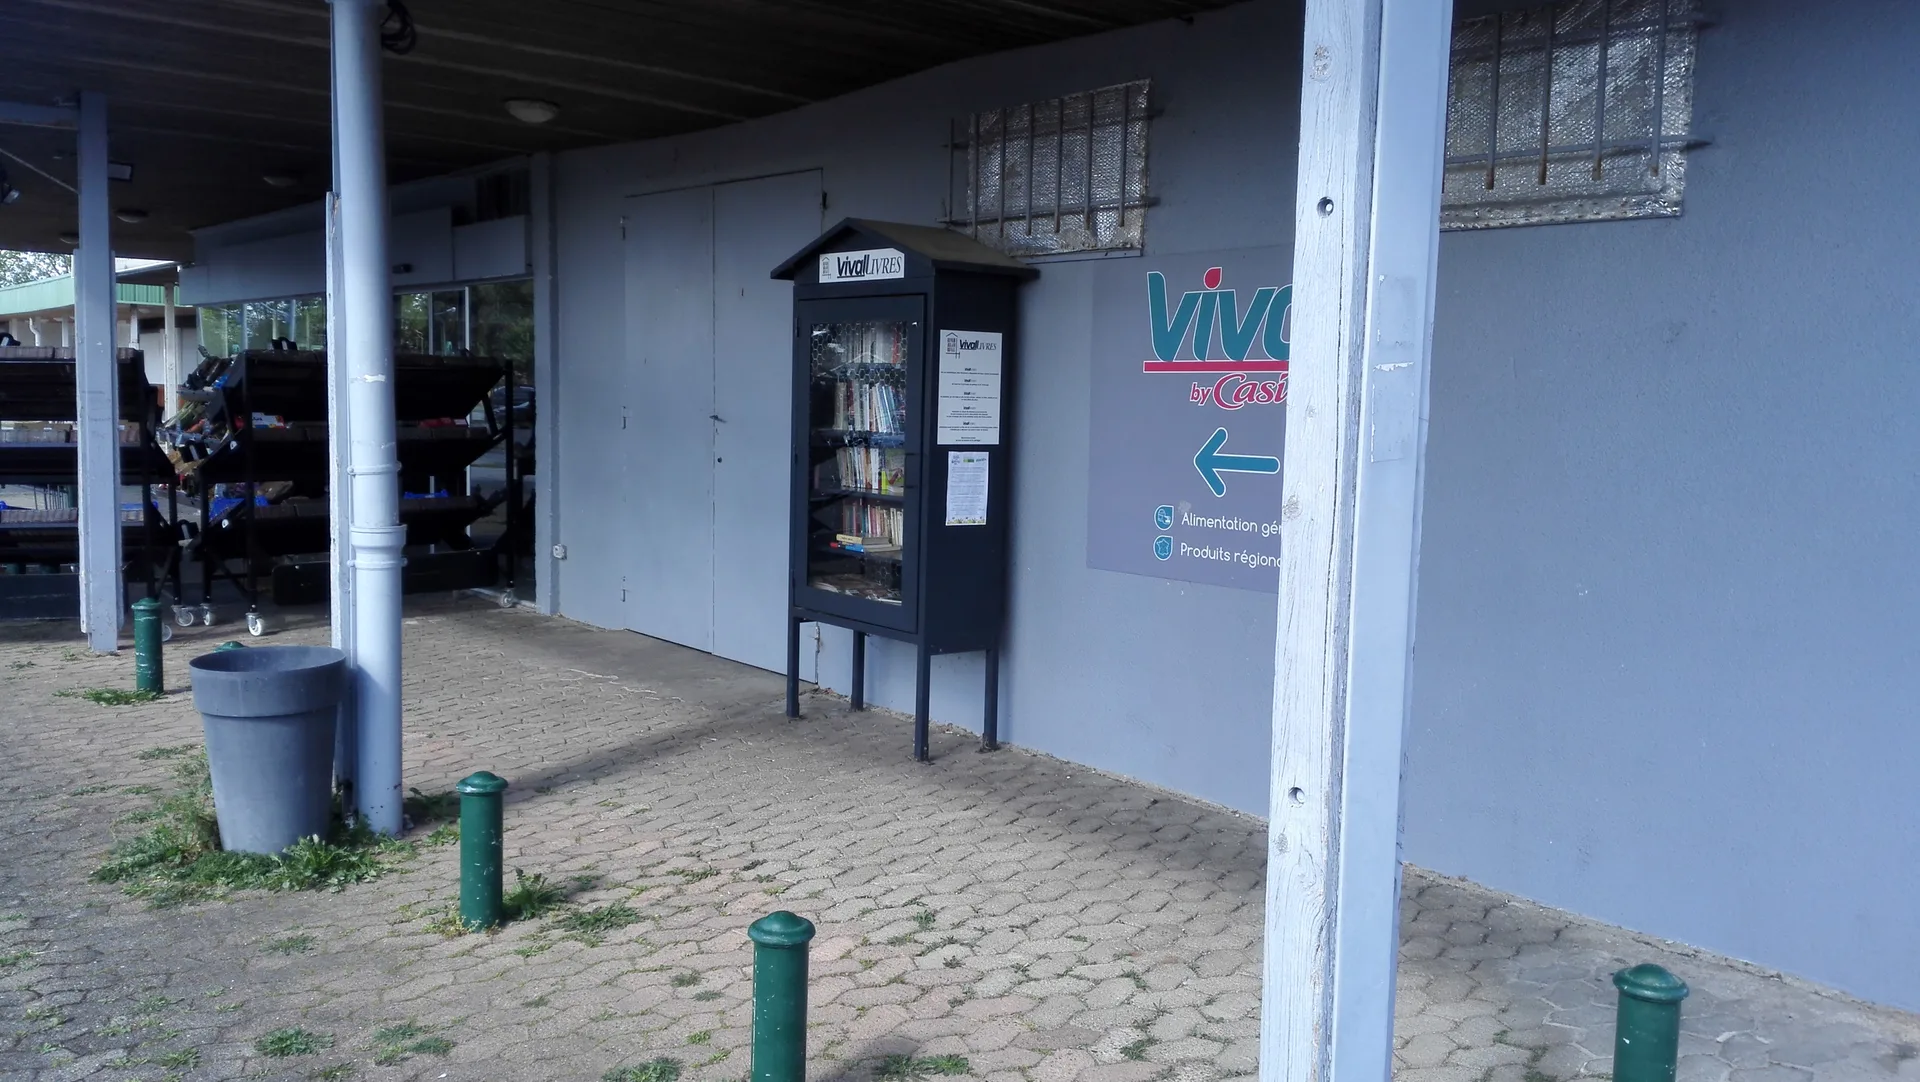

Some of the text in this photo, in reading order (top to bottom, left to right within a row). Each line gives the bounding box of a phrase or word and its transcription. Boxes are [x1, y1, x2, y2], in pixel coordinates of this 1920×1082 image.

[1190, 382, 1213, 406] by
[1181, 512, 1258, 533] Alimentation
[1180, 542, 1231, 562] Produits
